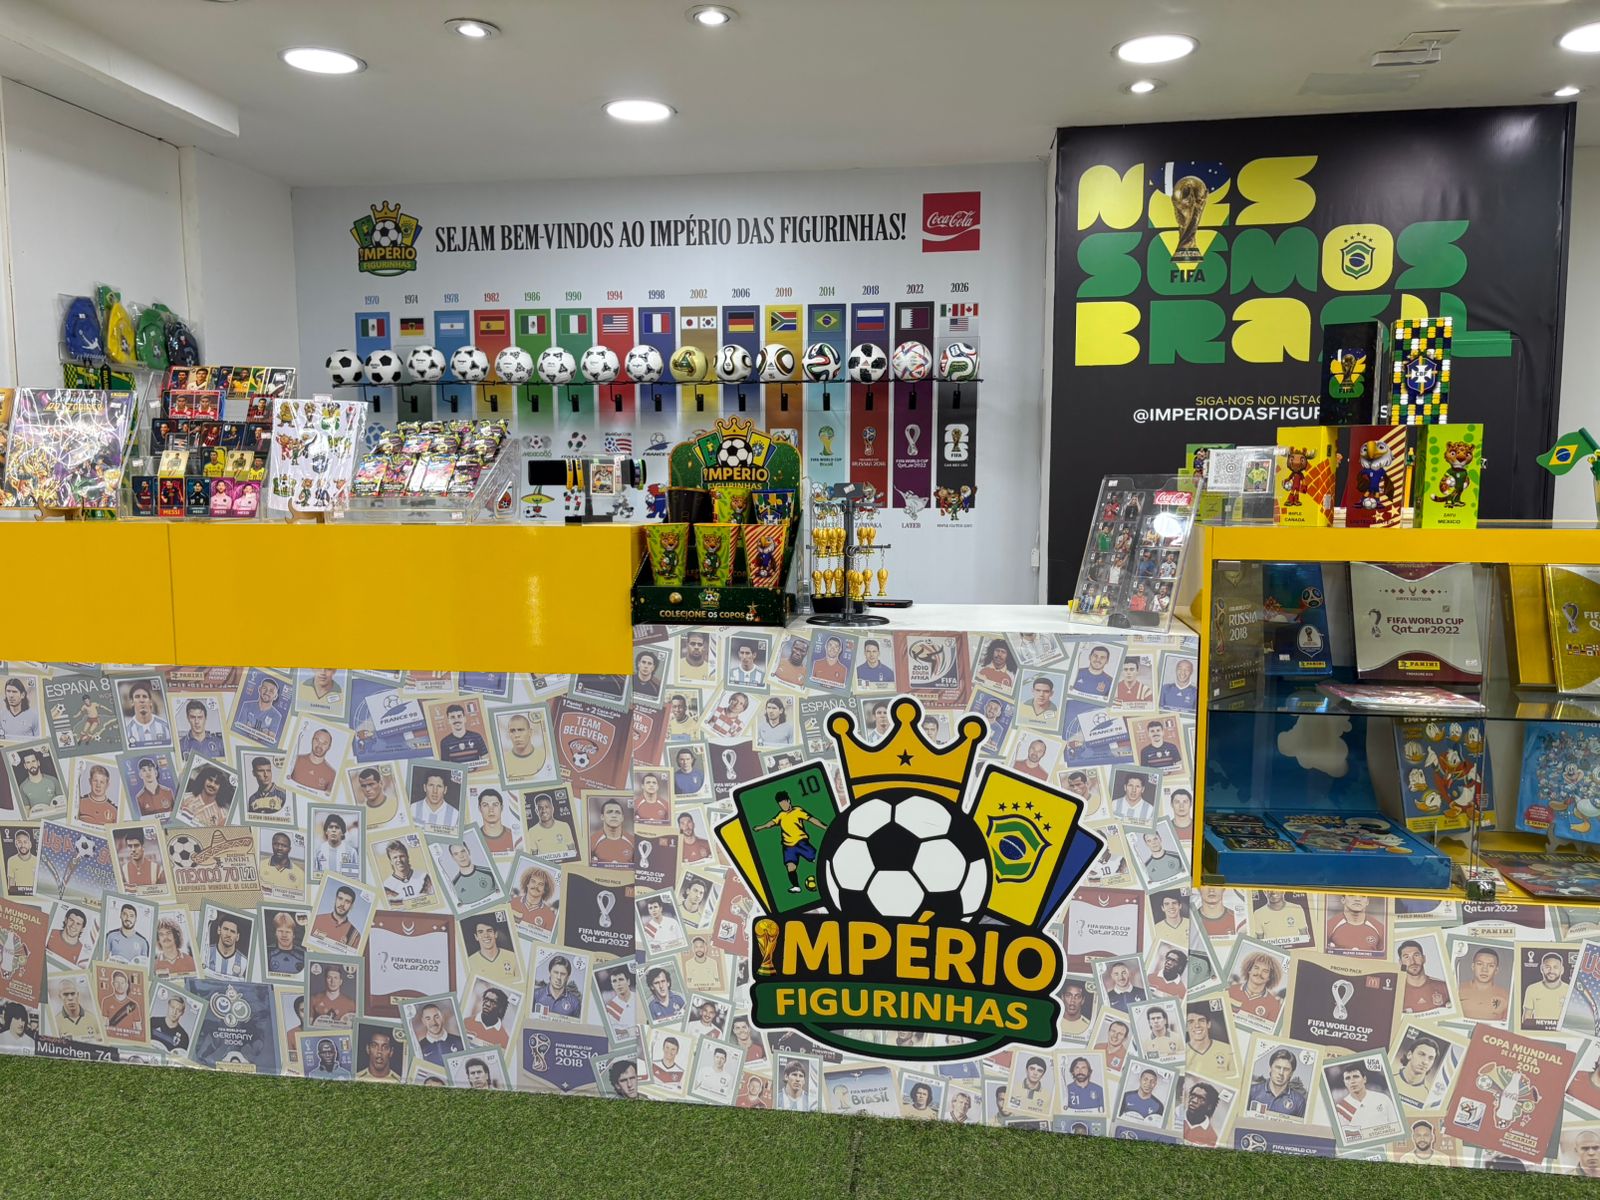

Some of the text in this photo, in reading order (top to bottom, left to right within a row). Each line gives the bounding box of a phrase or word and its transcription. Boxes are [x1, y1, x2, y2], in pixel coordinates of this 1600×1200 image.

[435, 212, 907, 253] SEJAM BEM-VINDOS AO IMPÉRIO DAS FIGURINHAS!
[1076, 219, 1471, 298] SOMOS
[1170, 269, 1206, 283] FIFA
[731, 288, 751, 298] 2006
[775, 287, 793, 297] 2010
[818, 286, 835, 296] 2014
[862, 285, 880, 296] 2018
[906, 283, 924, 294] 2022
[950, 282, 969, 293] 2026
[404, 294, 419, 304] 1974
[443, 293, 459, 303] 1978
[483, 292, 500, 302] 1982
[524, 292, 541, 302] 1986
[565, 291, 582, 301] 1990
[606, 290, 623, 300] 1994
[648, 289, 666, 300] 1998
[689, 288, 708, 299] 2002
[364, 295, 380, 305] 1970
[1195, 395, 1253, 406] SIGA-NOS
[1257, 395, 1276, 406] NO
[659, 609, 745, 618] COLECIONE OS COPOS
[1229, 612, 1257, 627] RUSSIA
[1387, 616, 1409, 624] FIFA
[1409, 617, 1443, 625] WORLD
[1230, 626, 1248, 641] 2018
[1391, 624, 1460, 635] Qatar2022
[379, 714, 406, 725] FRANCE
[576, 716, 602, 731] TEAM
[563, 725, 609, 745] BELIEVERS
[1089, 728, 1112, 737] FRANCE
[797, 775, 821, 797] 10
[42, 828, 74, 854] USA
[175, 866, 240, 884] MEXICO 70
[1101, 866, 1111, 876] 10
[403, 884, 414, 897] 10
[1463, 904, 1518, 914] Qatar2022
[4, 907, 42, 925] MUNDIAL
[578, 927, 593, 935] FIFA
[593, 929, 619, 939] WORLD
[580, 934, 629, 947] Qatar2022
[775, 987, 1029, 1030] FIGURINHAS
[1307, 1019, 1373, 1034] FIFA WORLD CUP
[212, 1031, 253, 1040] GERMANY
[1310, 1026, 1368, 1042] Qatar2022
[36, 1041, 112, 1062] München 74
[1482, 1034, 1563, 1065] COPA MUNDIAL
[555, 1056, 583, 1067] 2018
[1508, 1051, 1517, 1059] LA
[1517, 1053, 1538, 1066] FIFA
[1516, 1062, 1541, 1075] 2010
[851, 1091, 890, 1105] Brasil
[1071, 1095, 1080, 1104] 21
